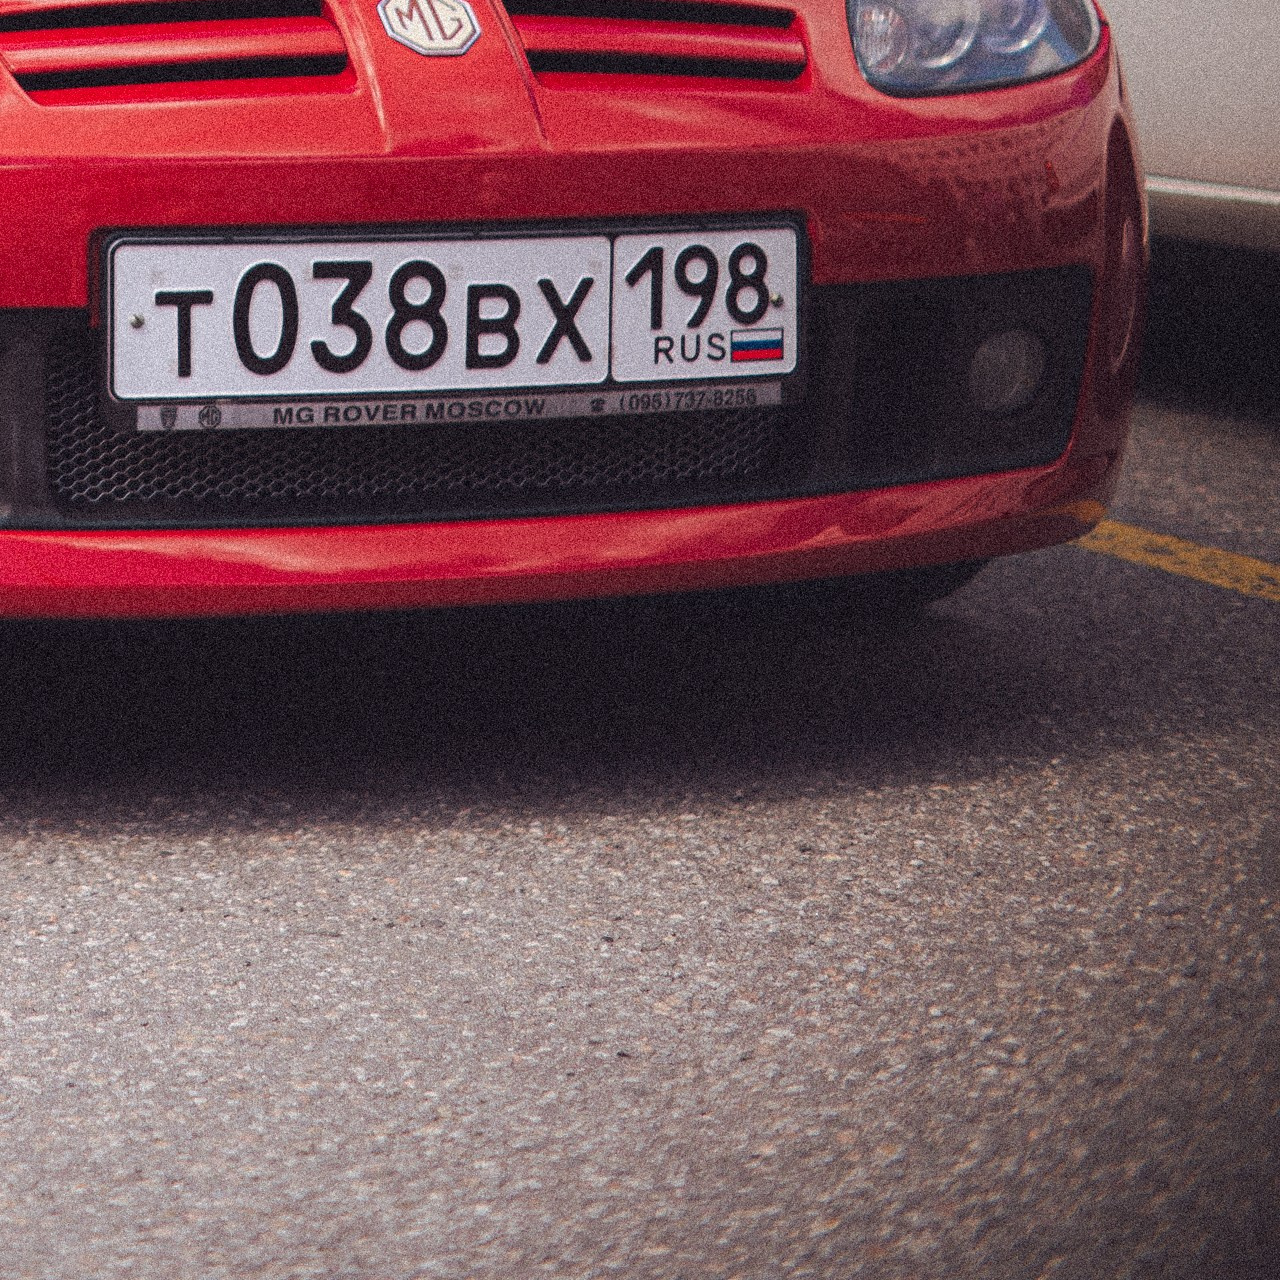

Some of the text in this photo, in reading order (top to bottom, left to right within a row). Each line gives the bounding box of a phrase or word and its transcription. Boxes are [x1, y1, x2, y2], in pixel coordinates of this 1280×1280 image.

[624, 242, 770, 330] 198
[653, 332, 727, 364] RUS
[273, 406, 315, 426] MG
[322, 403, 418, 424] ROVER
[424, 398, 548, 421] MOSCOW
